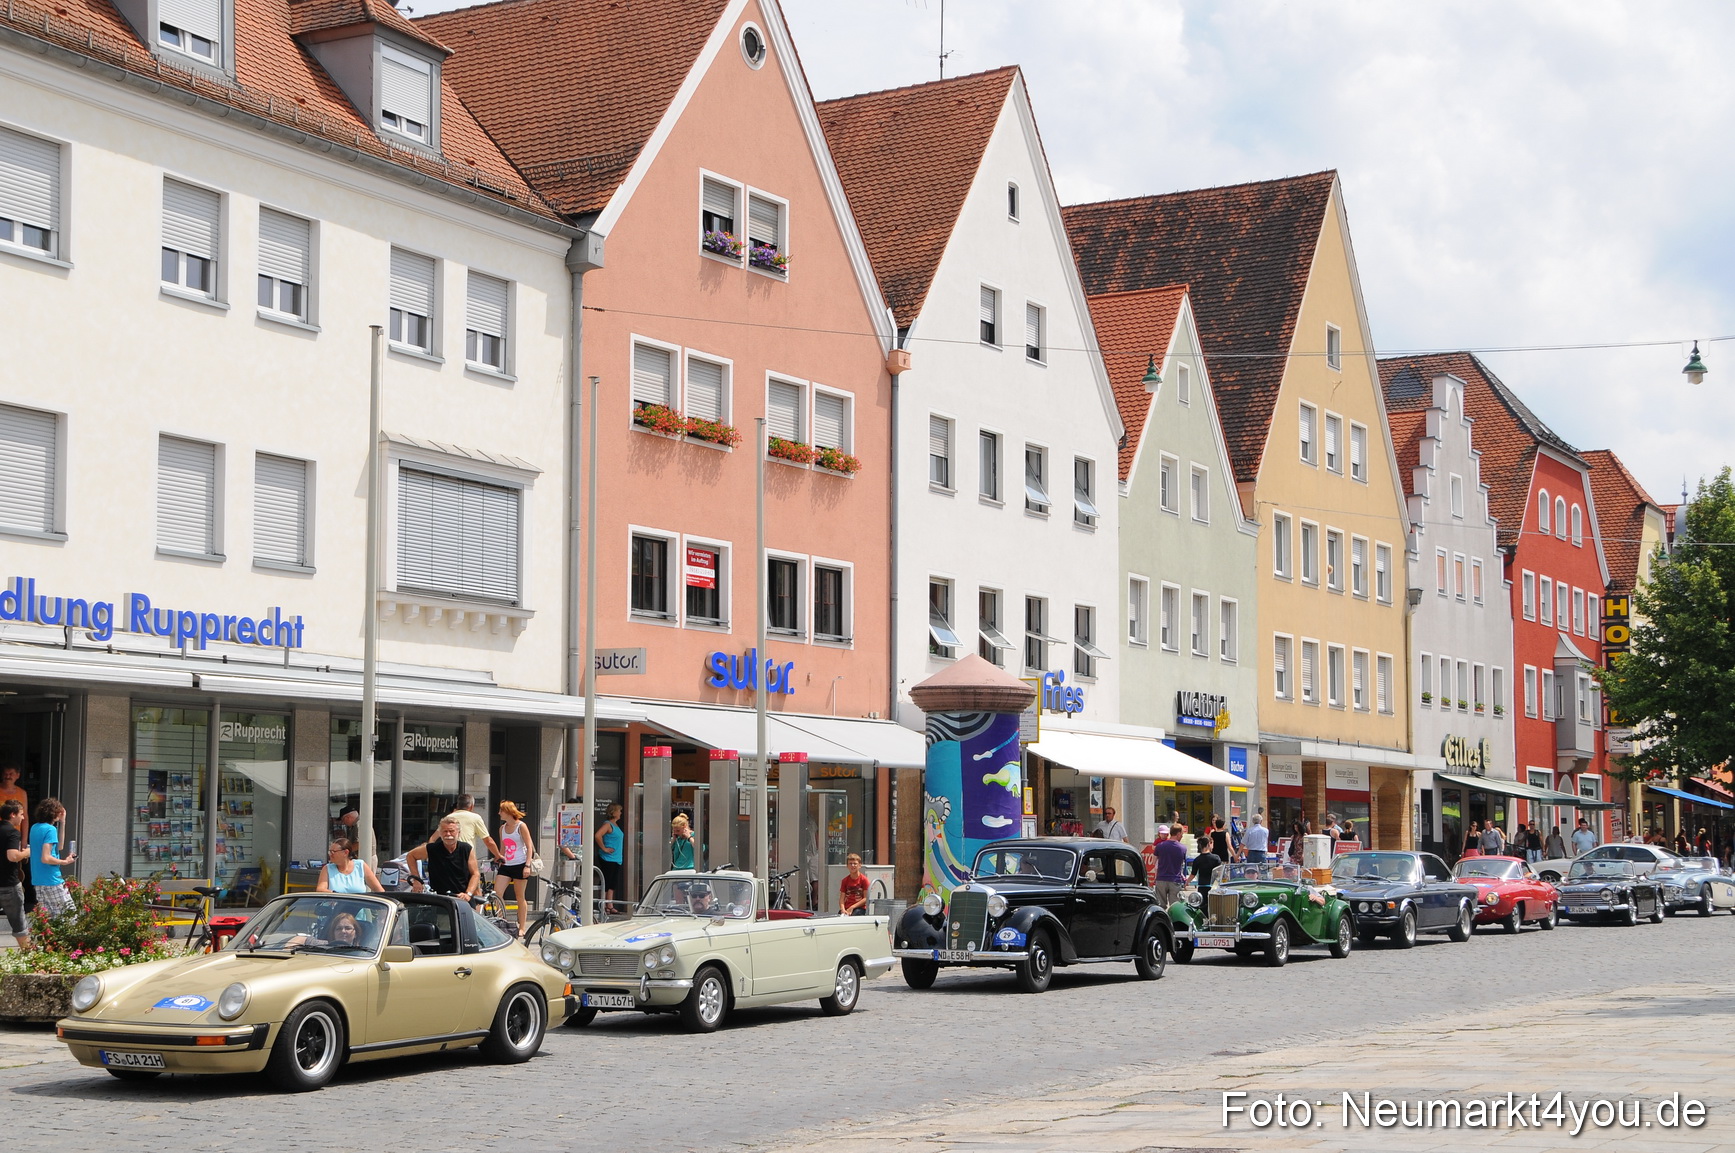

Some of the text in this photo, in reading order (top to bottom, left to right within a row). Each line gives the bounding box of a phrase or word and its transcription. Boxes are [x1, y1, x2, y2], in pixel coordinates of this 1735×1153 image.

[0, 576, 304, 650] dlung Rupprecht
[234, 722, 286, 743] Rupprecht
[415, 733, 459, 752] Rupprecht
[1230, 761, 1245, 772] Bücher
[1200, 938, 1209, 946] LL
